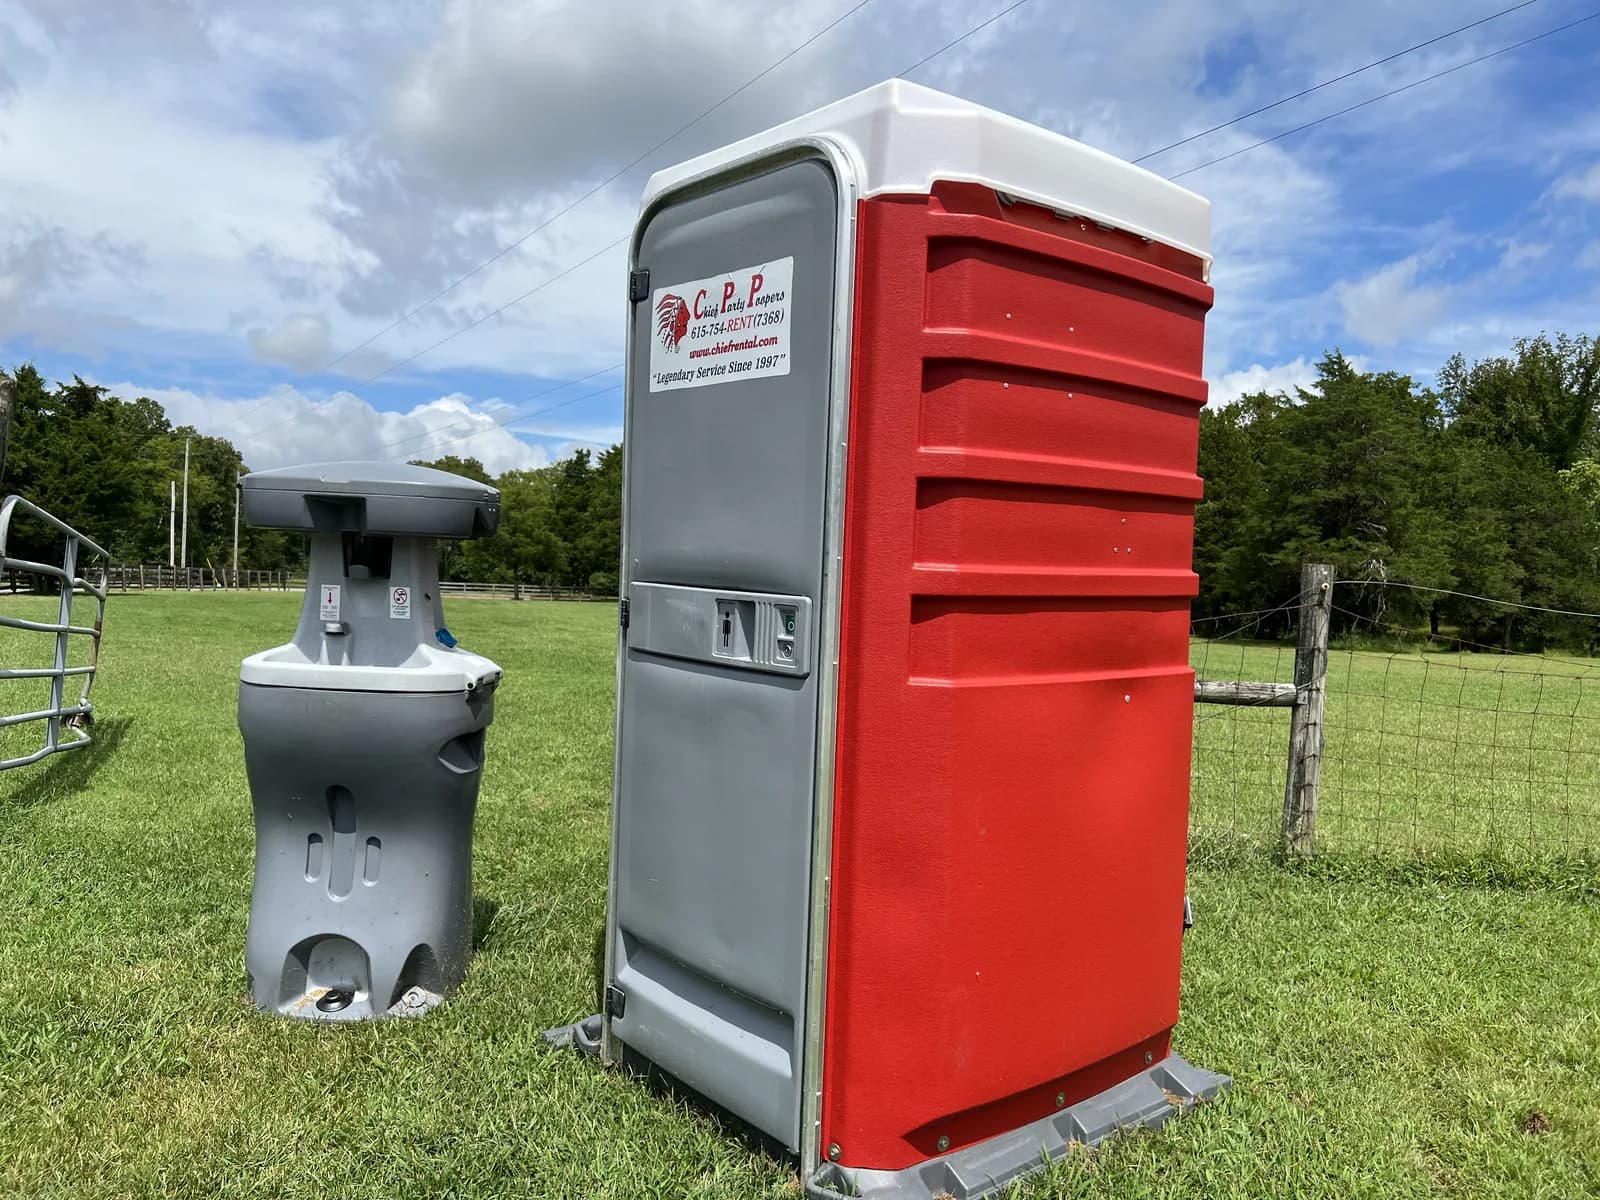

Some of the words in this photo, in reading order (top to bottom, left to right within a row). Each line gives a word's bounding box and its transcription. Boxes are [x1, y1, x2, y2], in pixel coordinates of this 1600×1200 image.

[694, 288, 719, 320] Chief
[720, 281, 746, 314] Party
[747, 273, 785, 308] Poopers
[689, 335, 778, 359] www.chiefrental.com
[696, 365, 726, 379] Service
[728, 359, 752, 372] Since
